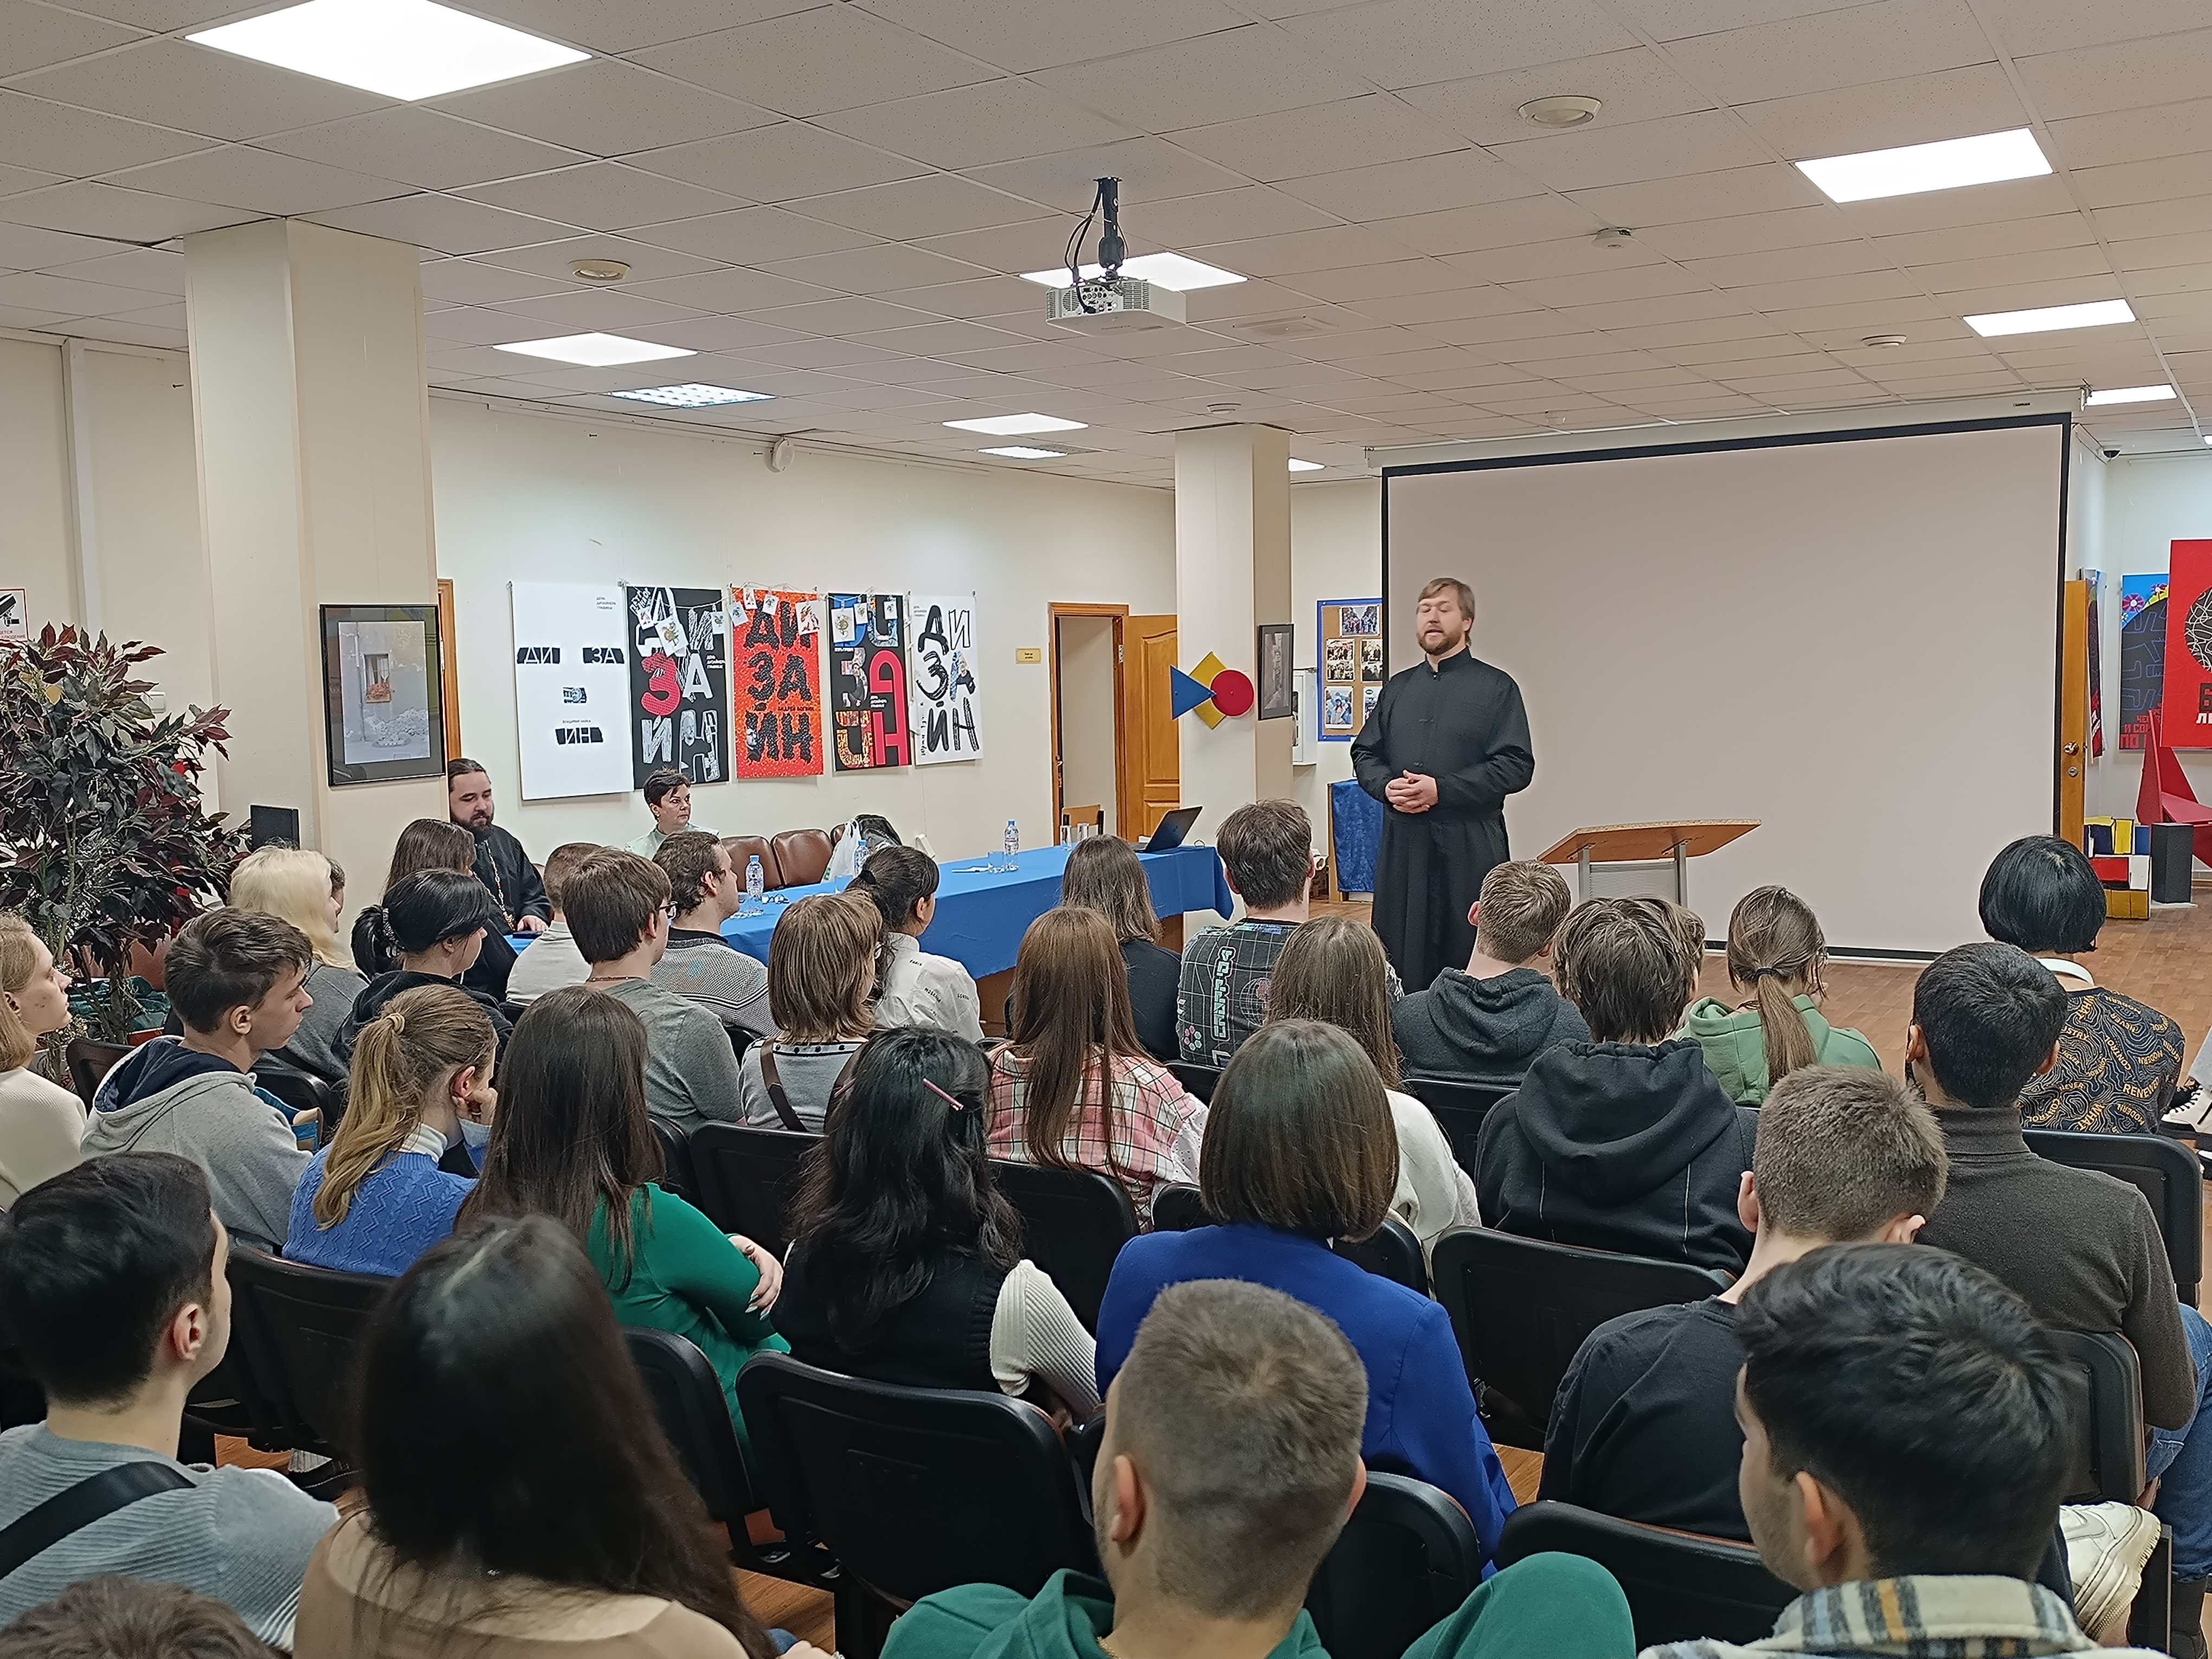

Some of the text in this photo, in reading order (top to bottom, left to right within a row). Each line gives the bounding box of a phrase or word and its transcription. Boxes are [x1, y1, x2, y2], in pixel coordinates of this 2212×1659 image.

[918, 605, 971, 656] ДИ
[748, 651, 813, 701] ЗА
[916, 651, 976, 702] ЗА
[2105, 1034, 2132, 1071] CONTROL
[2060, 1082, 2086, 1091] NEVER
[2077, 1103, 2105, 1131] WHAT
[2117, 1103, 2146, 1126] MODERN
